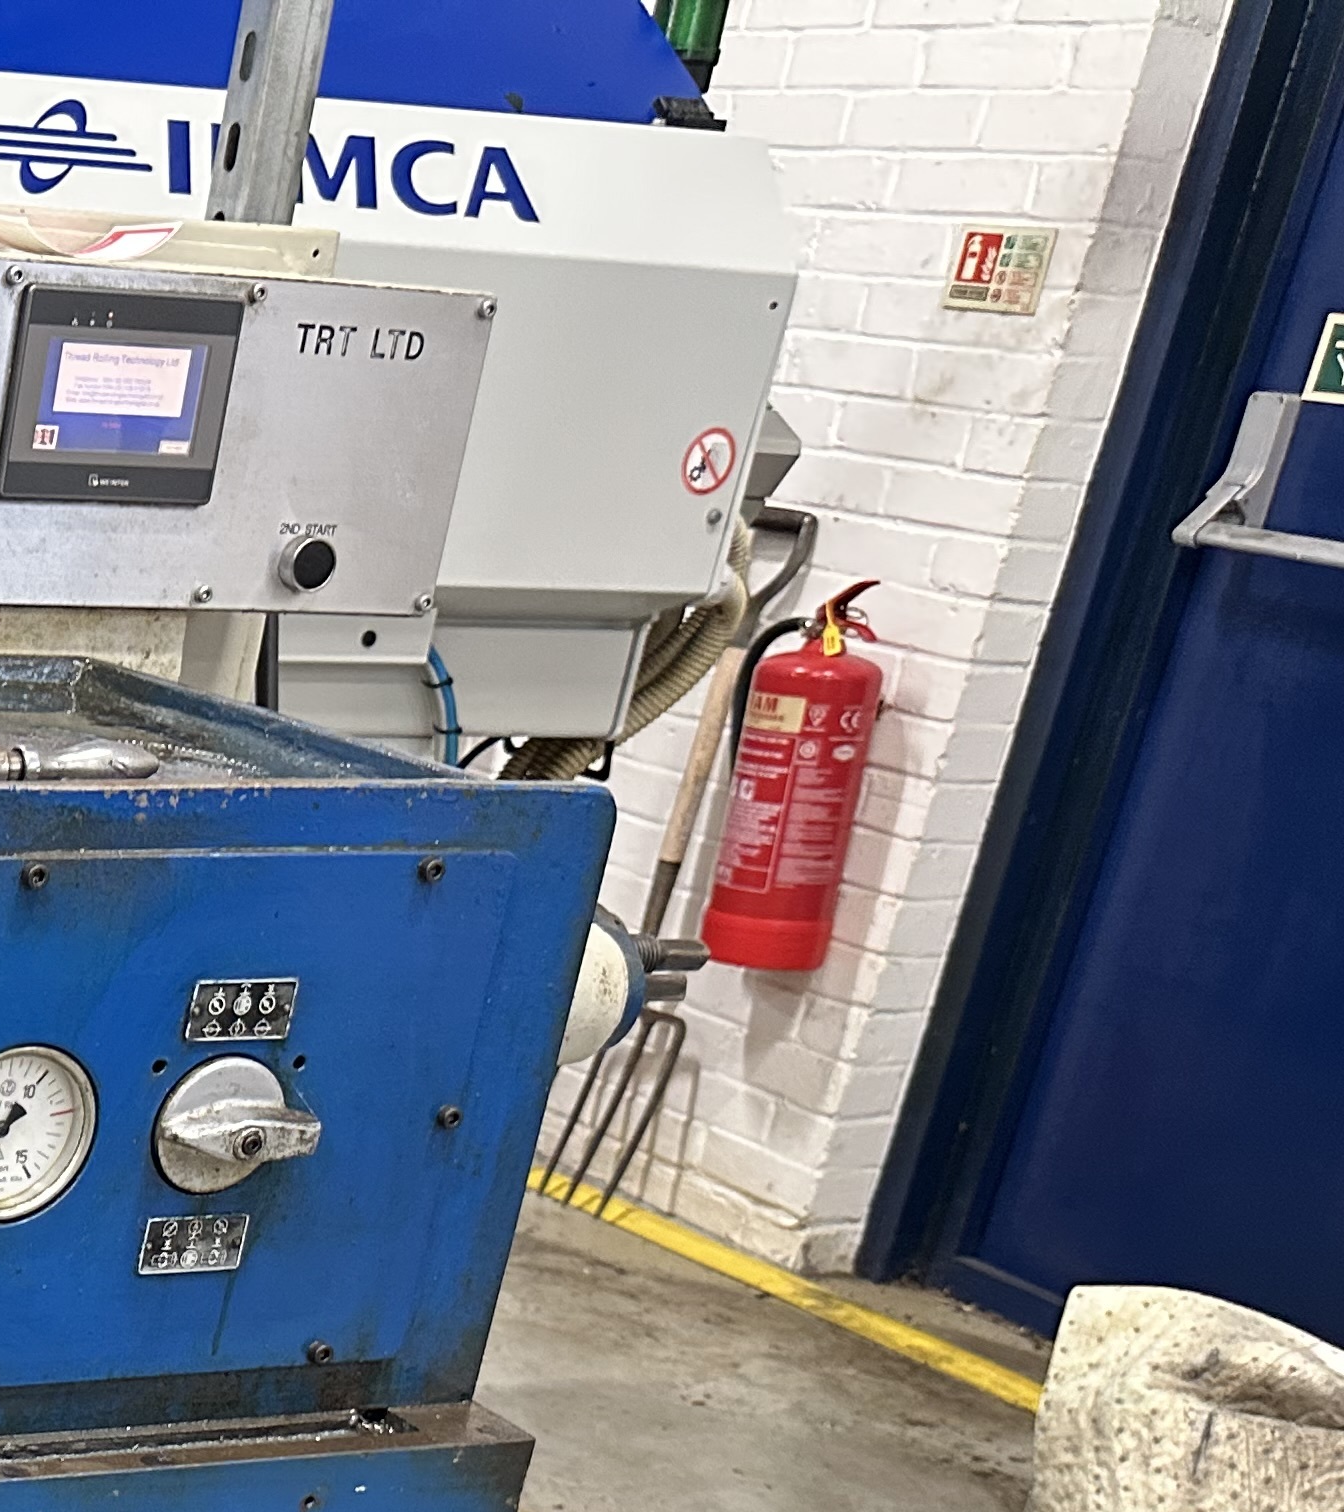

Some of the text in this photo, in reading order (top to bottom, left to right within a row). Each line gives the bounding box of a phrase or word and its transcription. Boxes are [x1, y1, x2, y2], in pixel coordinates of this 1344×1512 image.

[167, 118, 540, 223] IMCA
[297, 323, 425, 361] TRT LTD
[92, 352, 120, 366] Rolling
[279, 522, 338, 537] 2ND START
[23, 1084, 36, 1099] 10
[15, 1149, 28, 1164] 15
